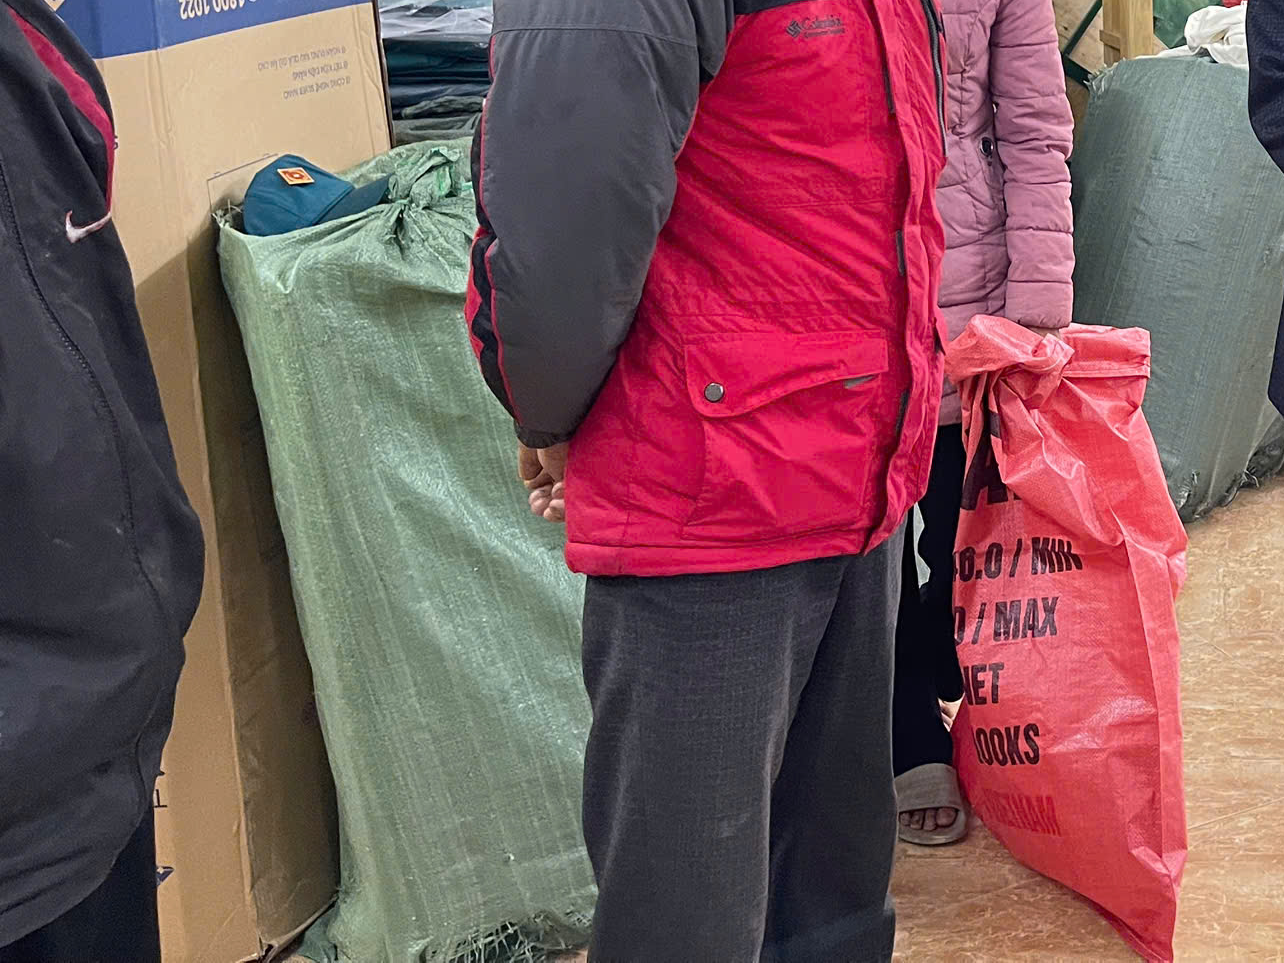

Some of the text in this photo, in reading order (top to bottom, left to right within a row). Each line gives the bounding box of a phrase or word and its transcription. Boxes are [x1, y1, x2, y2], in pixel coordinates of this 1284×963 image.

[1008, 538, 1023, 578] /
[1031, 536, 1083, 576] MIN
[971, 602, 987, 645] /
[993, 596, 1060, 642] MAX
[971, 723, 1040, 767] OOKS
